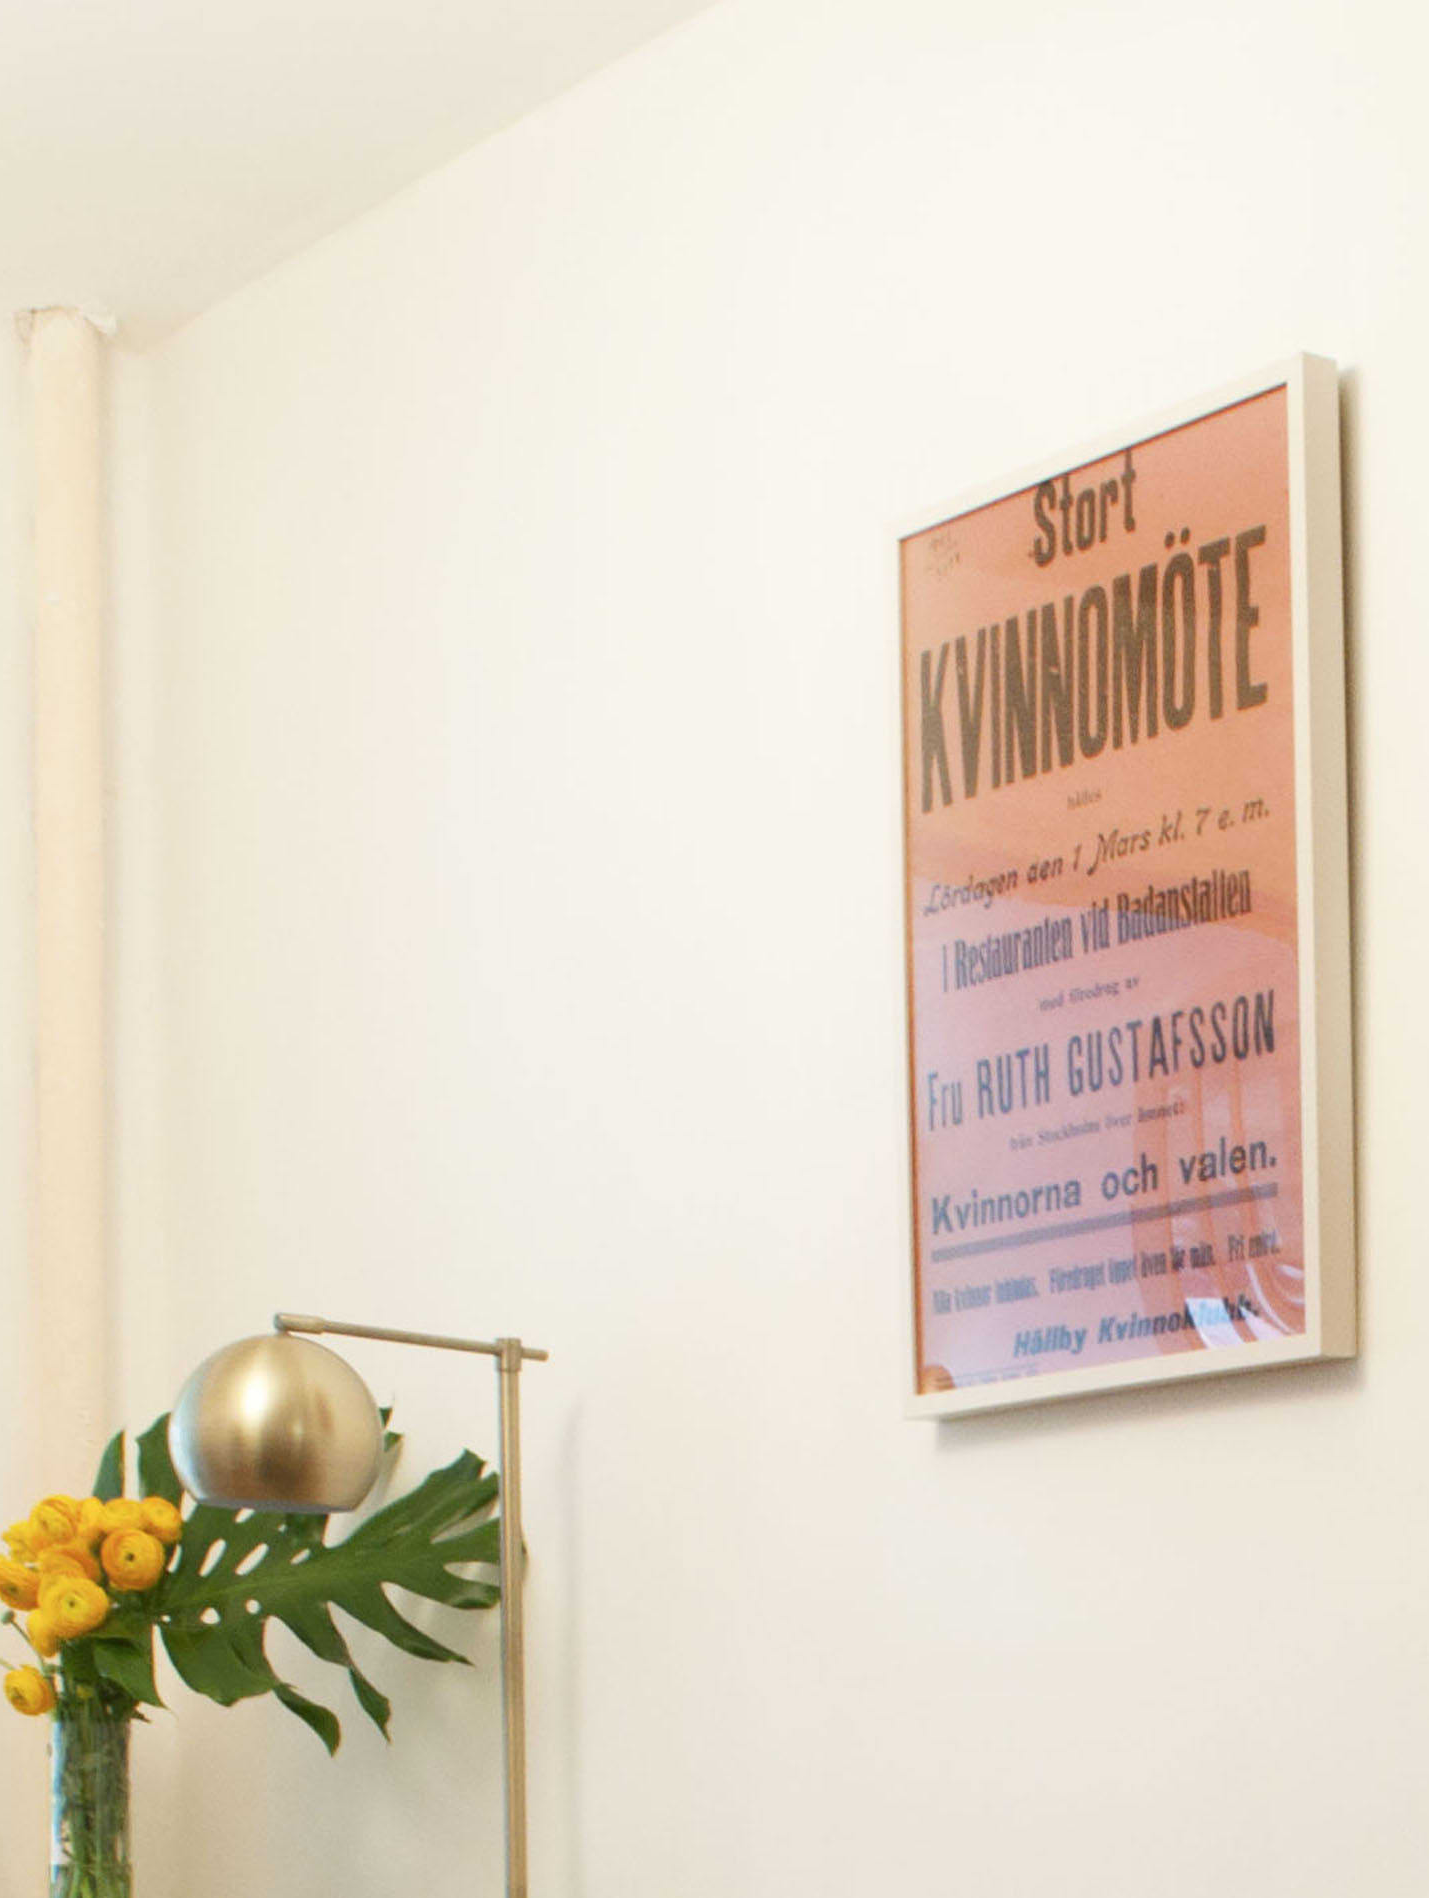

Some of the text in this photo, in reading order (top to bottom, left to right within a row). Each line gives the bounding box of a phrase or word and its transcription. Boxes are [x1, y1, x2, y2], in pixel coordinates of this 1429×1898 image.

[1033, 446, 1137, 568] Stort
[920, 525, 1269, 814] KVINNOMÖTE
[924, 874, 1018, 916] Lördagen
[1087, 829, 1152, 876] Mars
[1158, 810, 1185, 846] kl.
[1195, 807, 1211, 836] 7
[954, 916, 1074, 989] Restauranten
[1080, 897, 1110, 953] vid
[927, 990, 1276, 1131] Fru RUTH GUSTAFSSON
[932, 1136, 1277, 1235] Kvinnorna och valen.
